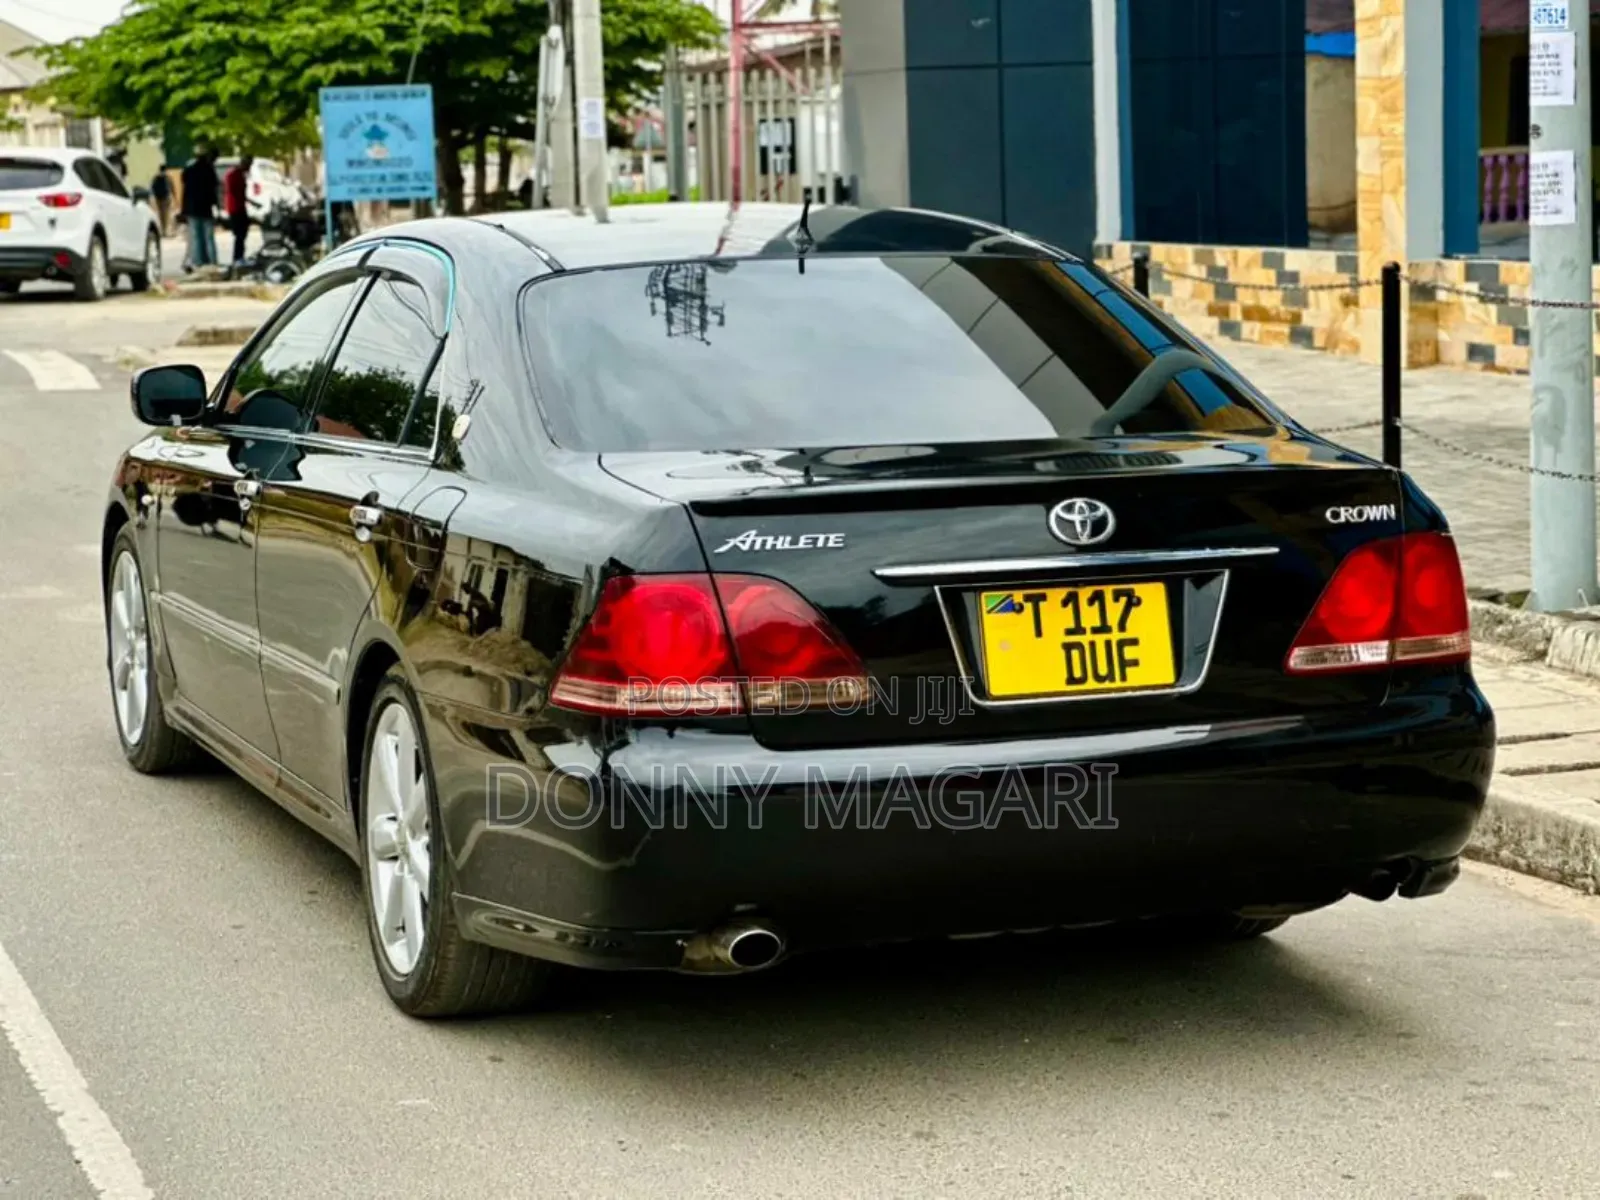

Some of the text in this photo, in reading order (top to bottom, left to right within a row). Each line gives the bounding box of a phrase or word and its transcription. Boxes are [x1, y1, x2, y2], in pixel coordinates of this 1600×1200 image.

[1325, 504, 1396, 524] CROWN
[1022, 588, 1137, 638] T 117
[1061, 637, 1140, 686] DUF
